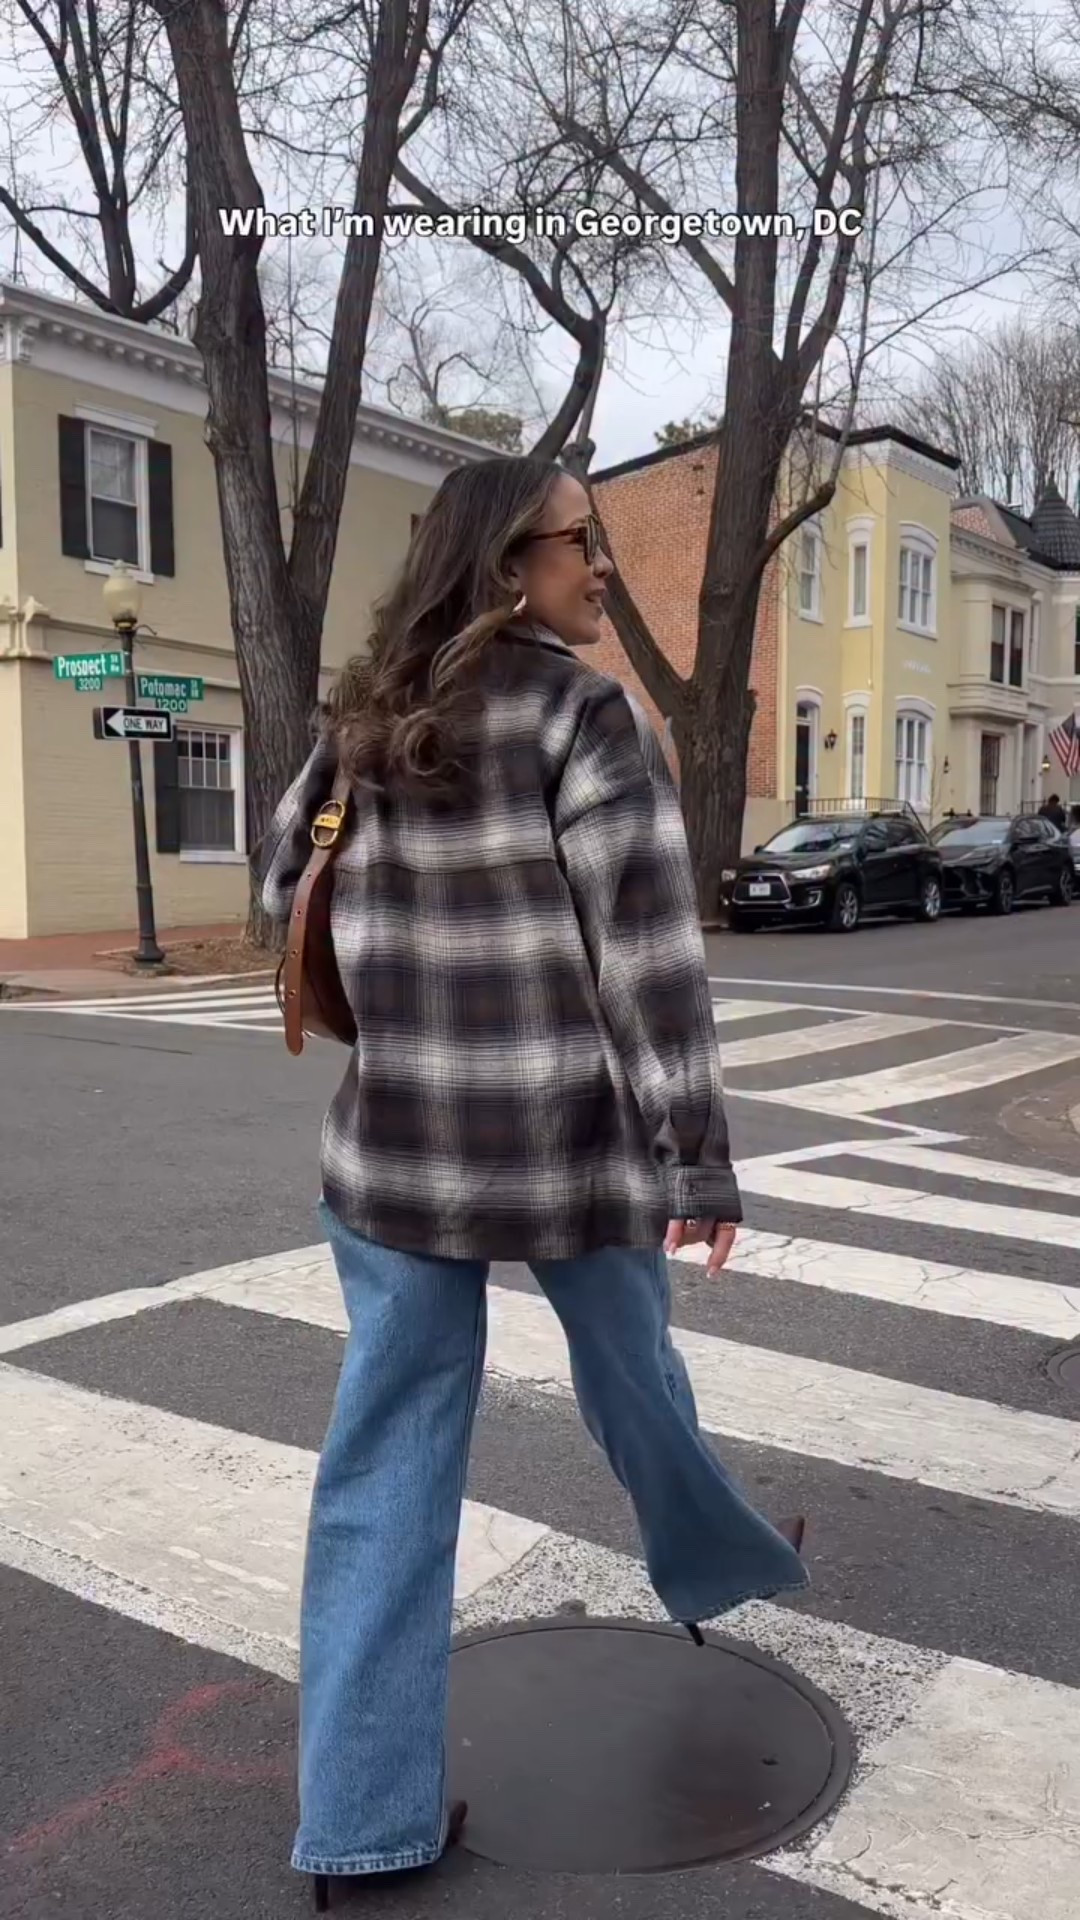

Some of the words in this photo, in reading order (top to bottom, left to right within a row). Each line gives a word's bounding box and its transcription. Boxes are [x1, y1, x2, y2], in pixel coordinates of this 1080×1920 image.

[57, 653, 106, 677] Prospect
[140, 677, 187, 697] Potomac
[157, 699, 187, 711] 1200
[123, 717, 142, 730] ONE
[145, 718, 164, 731] WAY
